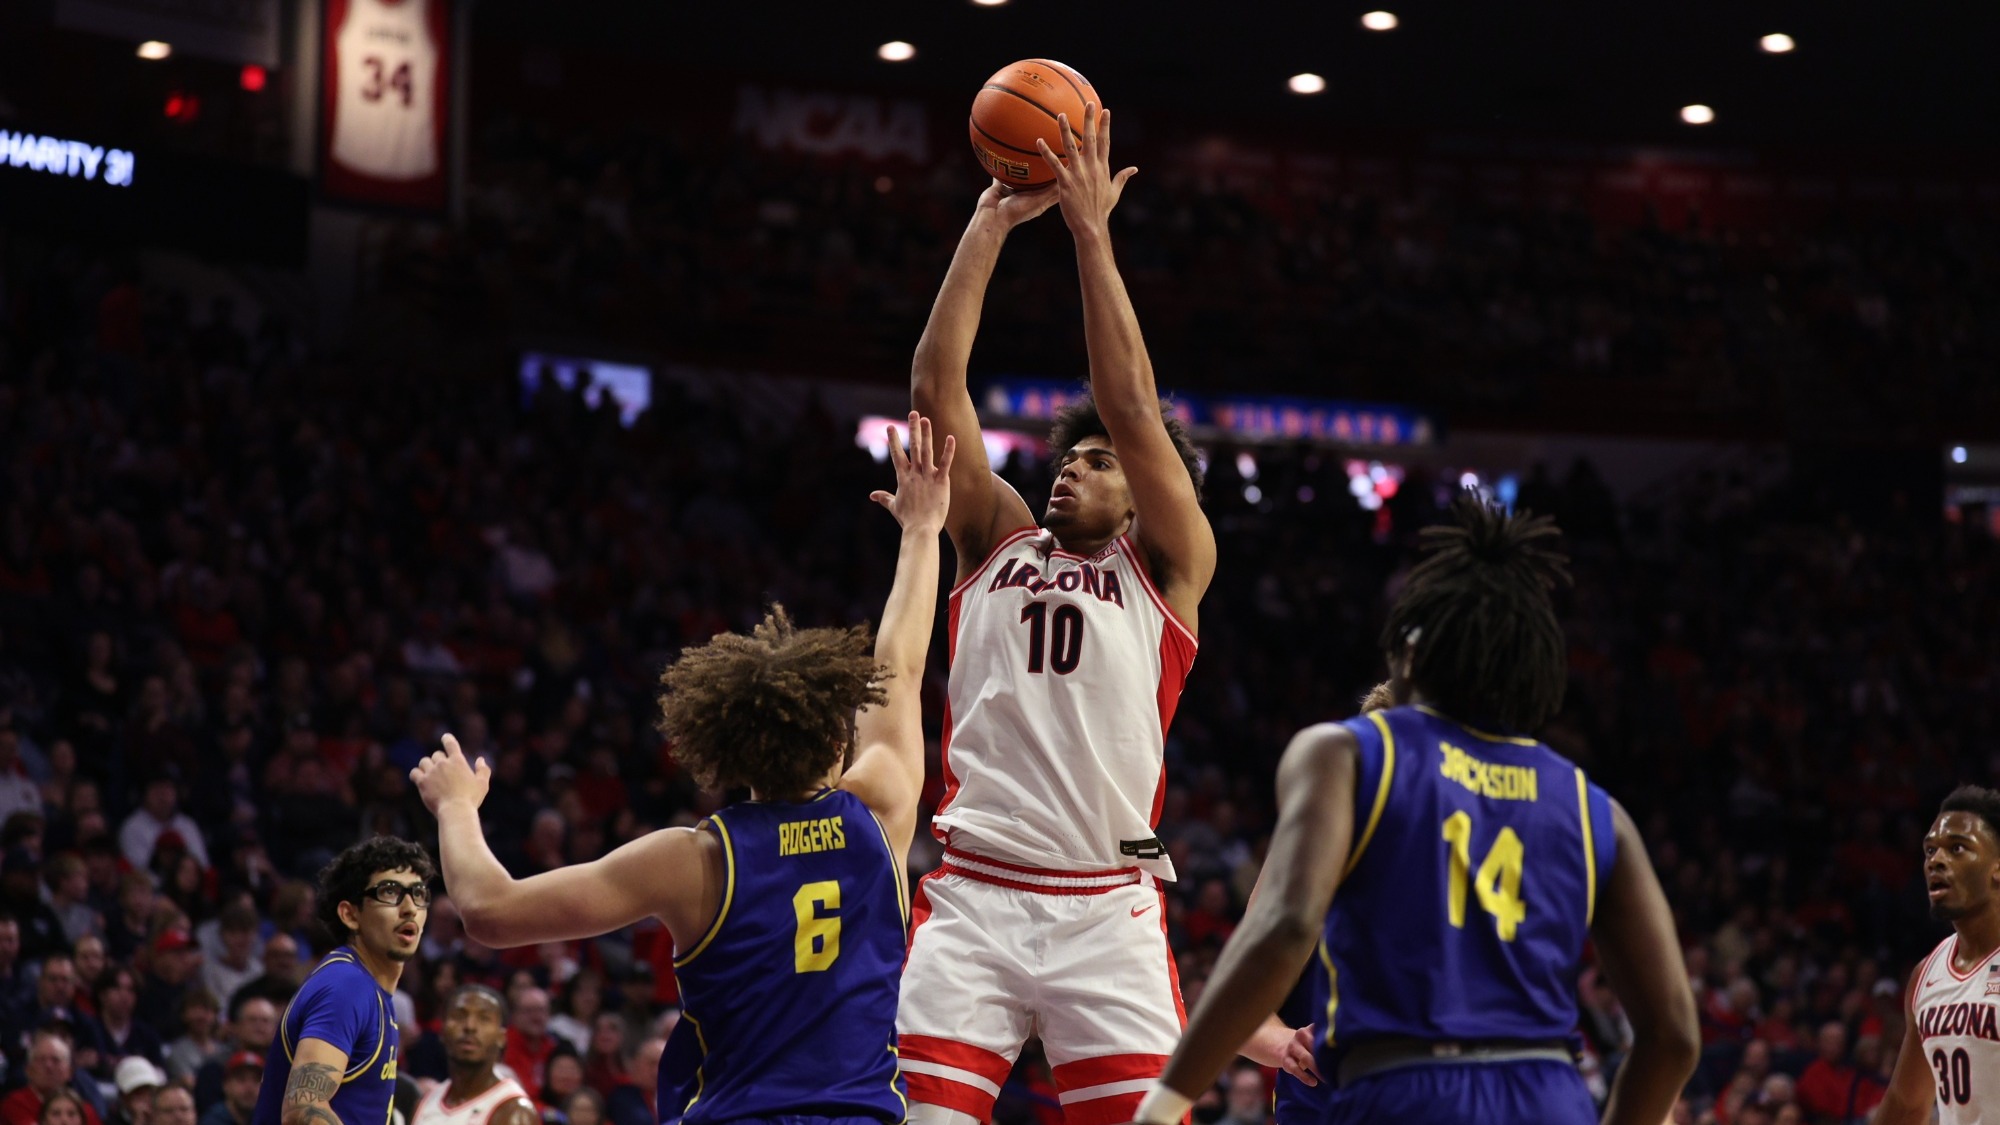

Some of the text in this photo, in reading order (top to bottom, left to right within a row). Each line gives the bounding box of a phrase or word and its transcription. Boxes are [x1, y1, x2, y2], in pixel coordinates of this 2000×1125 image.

[362, 56, 412, 108] 34
[735, 86, 928, 162] NCAA
[1020, 602, 1084, 675] 10
[1439, 741, 1538, 802] JACKSON
[778, 816, 846, 857] ROGERS
[1441, 809, 1526, 942] 14
[792, 880, 841, 974] 6
[1919, 1002, 2000, 1043] ARIZONA
[1933, 1047, 1971, 1106] 30
